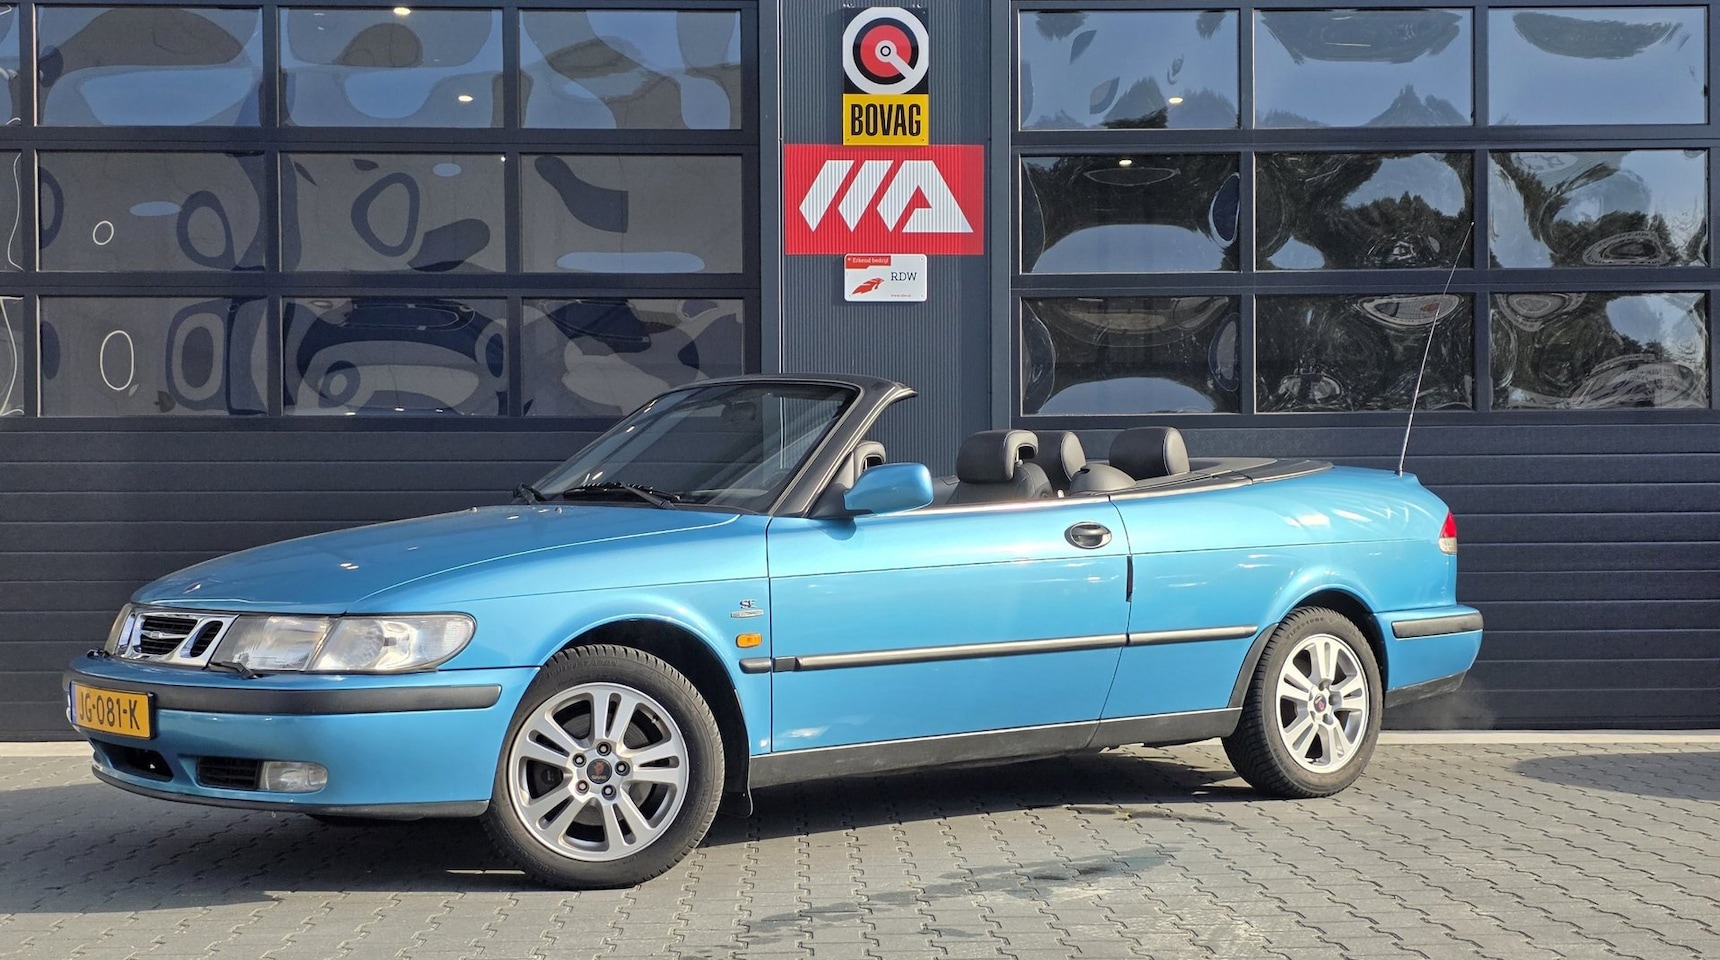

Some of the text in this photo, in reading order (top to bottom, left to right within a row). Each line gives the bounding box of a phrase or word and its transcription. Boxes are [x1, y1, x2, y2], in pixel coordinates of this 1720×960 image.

[850, 103, 921, 136] BOVAG
[890, 272, 917, 281] RDW
[740, 599, 757, 609] SE
[79, 691, 140, 730] JG-081-K
